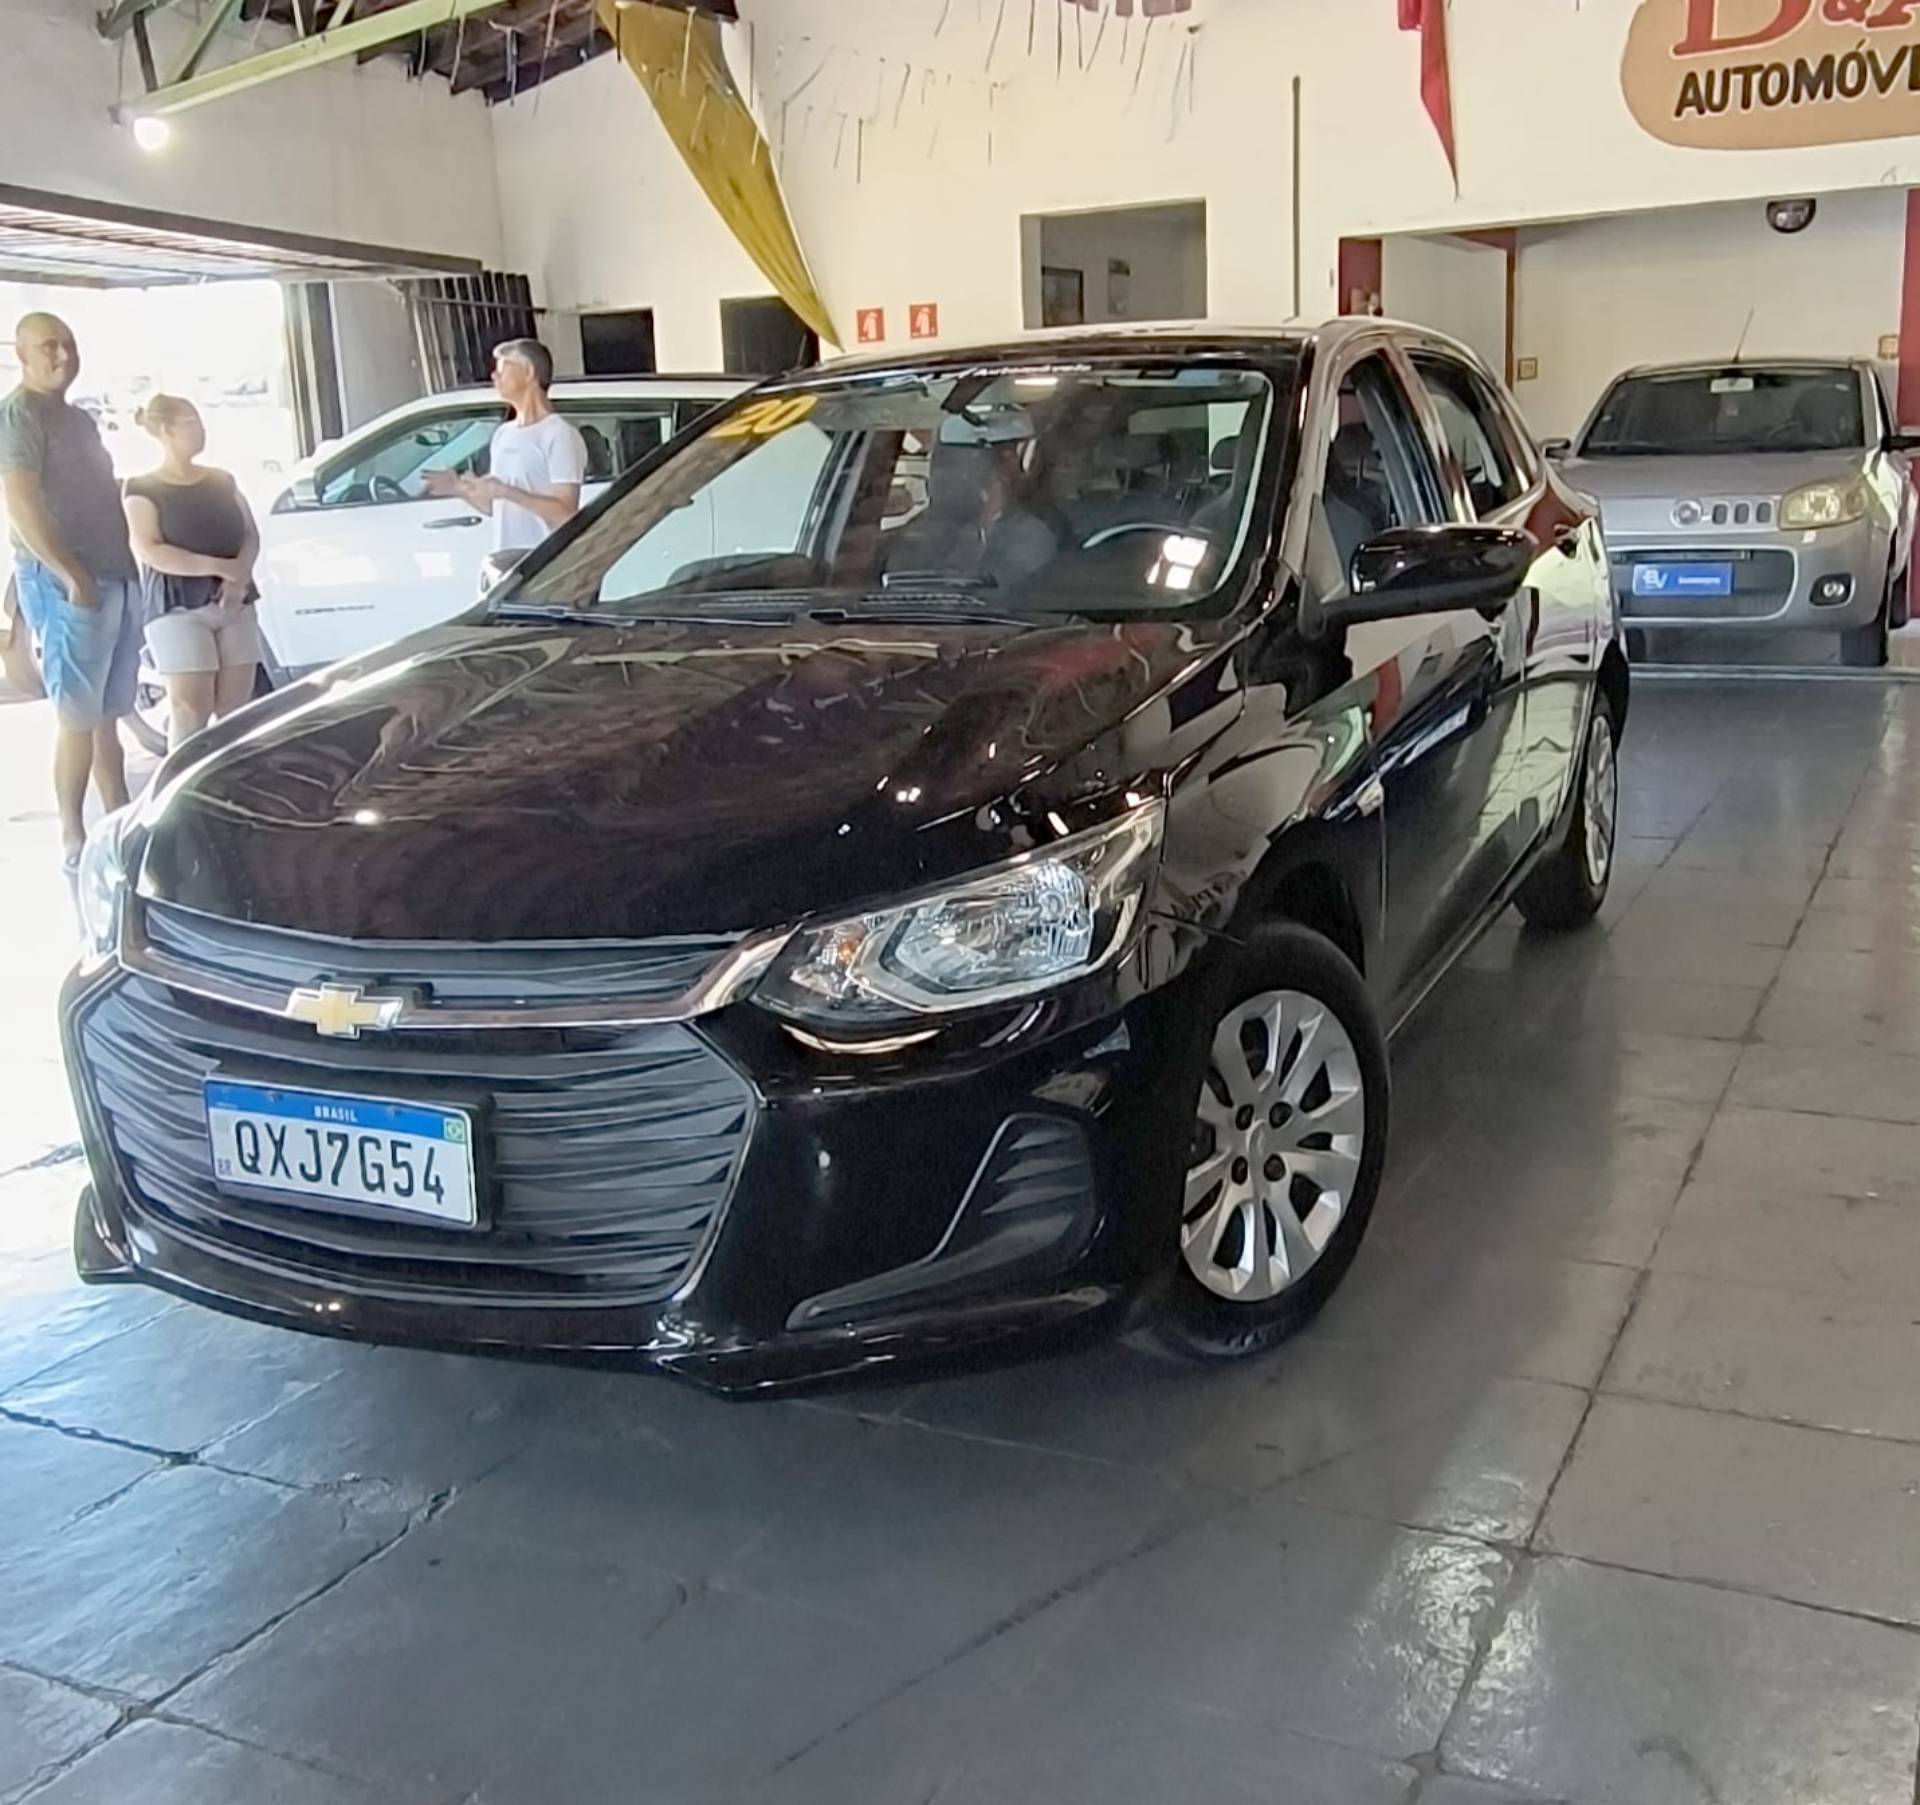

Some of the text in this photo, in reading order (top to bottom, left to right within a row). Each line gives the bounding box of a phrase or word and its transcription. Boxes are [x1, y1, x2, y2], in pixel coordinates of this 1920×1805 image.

[708, 394, 818, 438] 20
[314, 1104, 358, 1123] BRASIL
[235, 1119, 445, 1205] QXJ7G54
